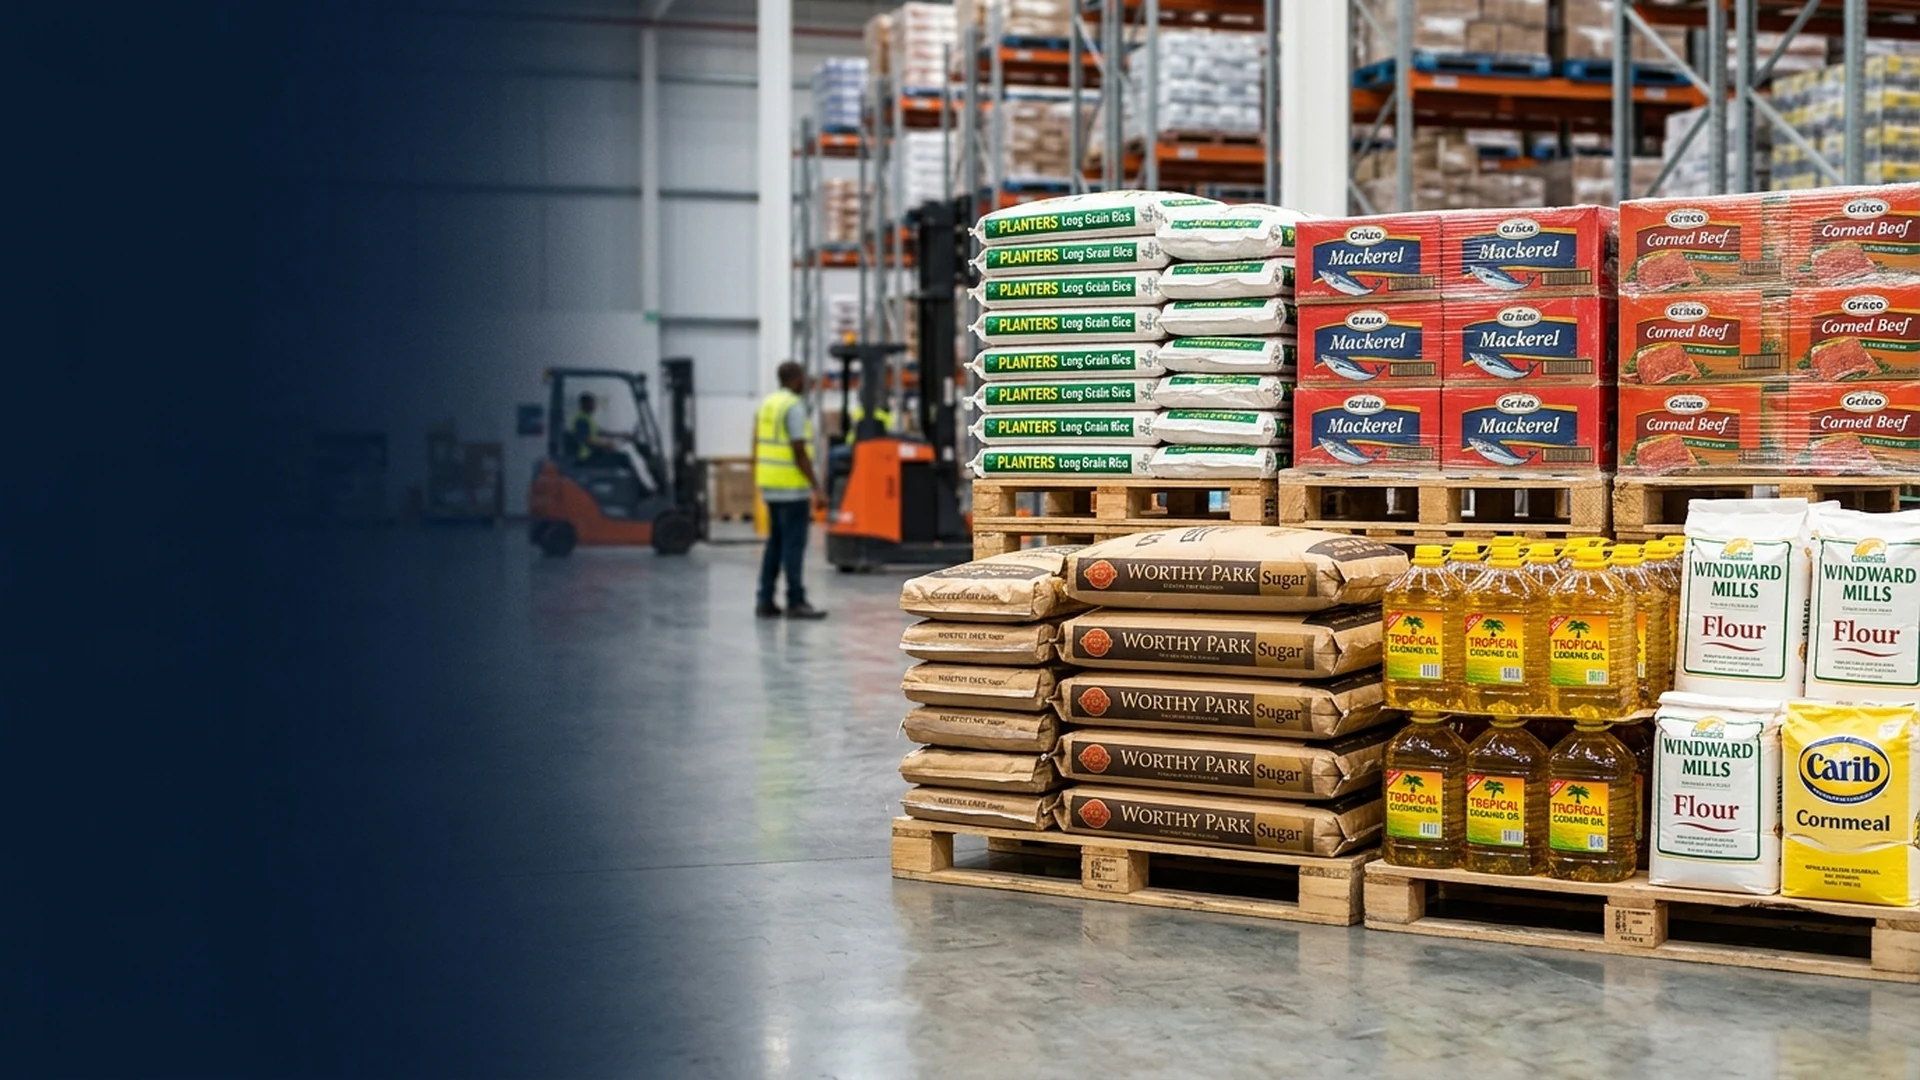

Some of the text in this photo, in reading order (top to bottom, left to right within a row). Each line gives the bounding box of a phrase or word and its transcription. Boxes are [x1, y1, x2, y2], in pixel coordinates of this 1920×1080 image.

[999, 216, 1058, 234] PLANTERS
[1822, 222, 1874, 237] Corned
[1647, 232, 1695, 246] Corned
[1000, 249, 1058, 264] PLANTERS
[1328, 246, 1404, 265] Mackerel
[1479, 240, 1560, 259] Mackerel
[1000, 282, 1058, 296] PLANTERS
[999, 317, 1058, 332] PLANTERS
[1646, 325, 1695, 338] Corned
[1822, 318, 1874, 334] Corned
[1330, 332, 1406, 350] Mackerel
[1479, 330, 1560, 347] Mackerel
[999, 355, 1057, 369] PLANTERS
[1000, 388, 1057, 401] PLANTERS
[999, 421, 1056, 433] PLANTERS
[1327, 417, 1404, 433] Mackerel
[1479, 416, 1560, 433] Mackerel
[1876, 414, 1911, 432] Beef
[998, 456, 1055, 469] PLANTERS
[1127, 564, 1307, 590] WORTHY PARK Sugar
[1694, 562, 1781, 580] WINDWARD
[1824, 564, 1916, 583] WINDWARD
[1712, 581, 1758, 598] MILLS
[1843, 585, 1892, 602] MILLS
[1702, 616, 1766, 640] Flour
[1833, 620, 1900, 644] Flour
[1122, 633, 1303, 661] WORTHY PARK Sugar
[1553, 640, 1605, 650] TROPICAL
[1121, 692, 1301, 724] WORTHY PARK Sugar
[1664, 738, 1753, 758] WINDWARD
[1121, 750, 1201, 772] WORTHY
[1205, 755, 1251, 776] PARK
[1256, 764, 1302, 784] Sugar
[1682, 760, 1730, 777] MILLS
[1807, 753, 1880, 782] Carib
[1674, 795, 1739, 820] Flour
[1121, 805, 1303, 843] WORTHY PARK Sugar
[1796, 809, 1890, 831] Cornmeal
